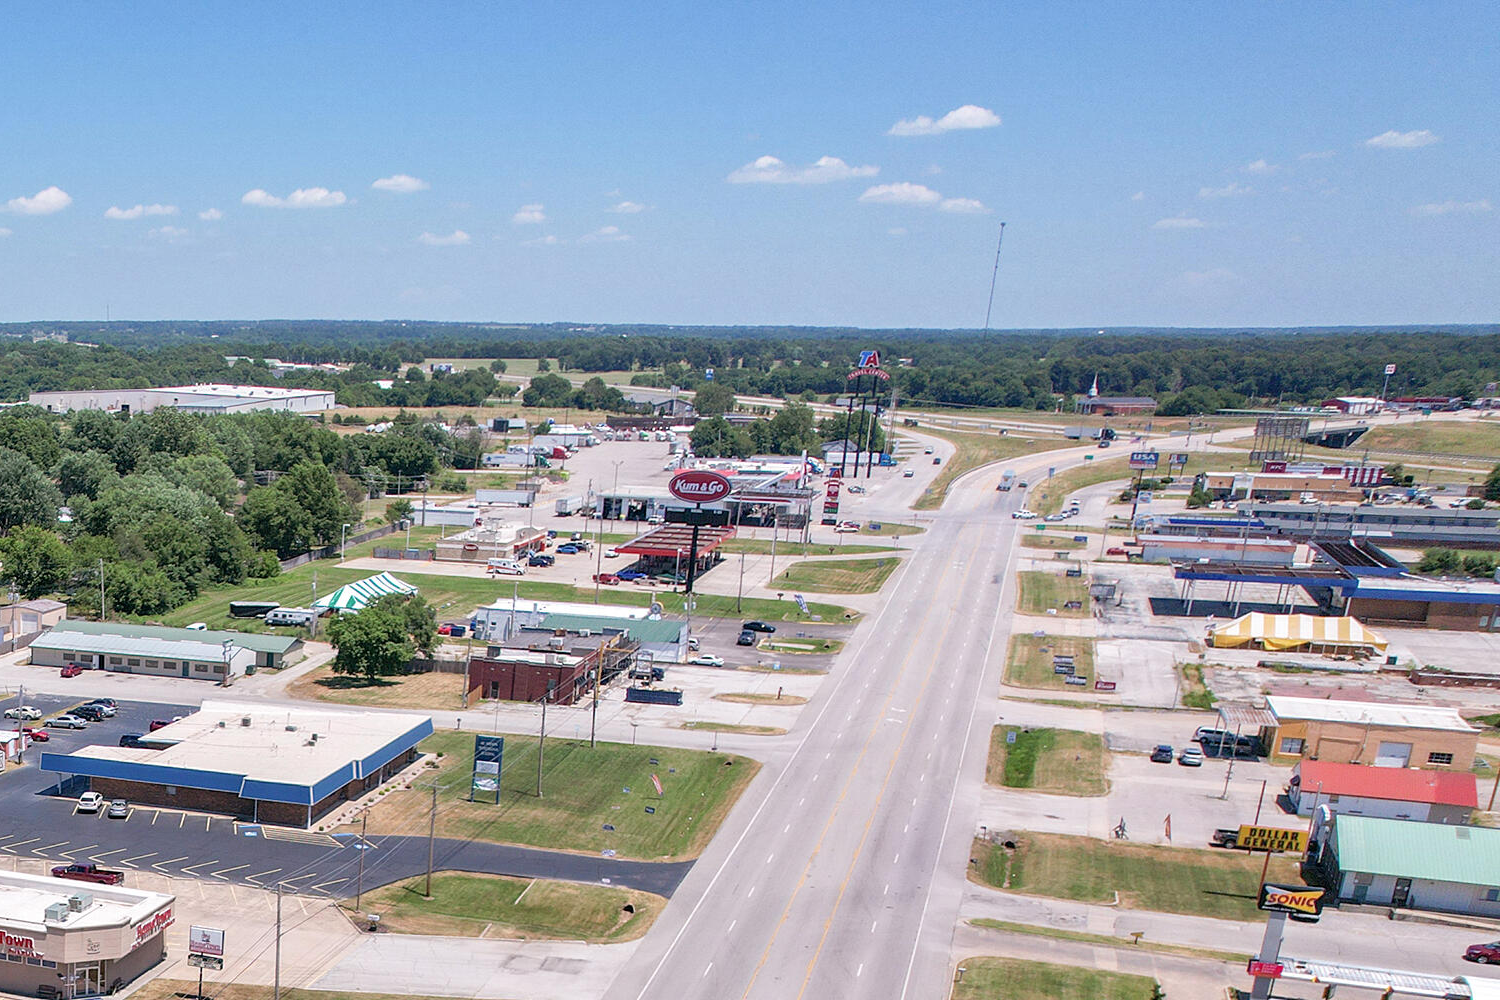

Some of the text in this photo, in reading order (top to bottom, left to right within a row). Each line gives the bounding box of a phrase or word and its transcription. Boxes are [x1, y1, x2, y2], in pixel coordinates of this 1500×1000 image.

[858, 351, 879, 367] TA
[869, 369, 890, 380] CENTER
[675, 480, 724, 494] Kum & Go
[1249, 828, 1299, 841] DOLLAR
[1243, 837, 1300, 850] GENERAL
[1267, 893, 1317, 907] SONIC
